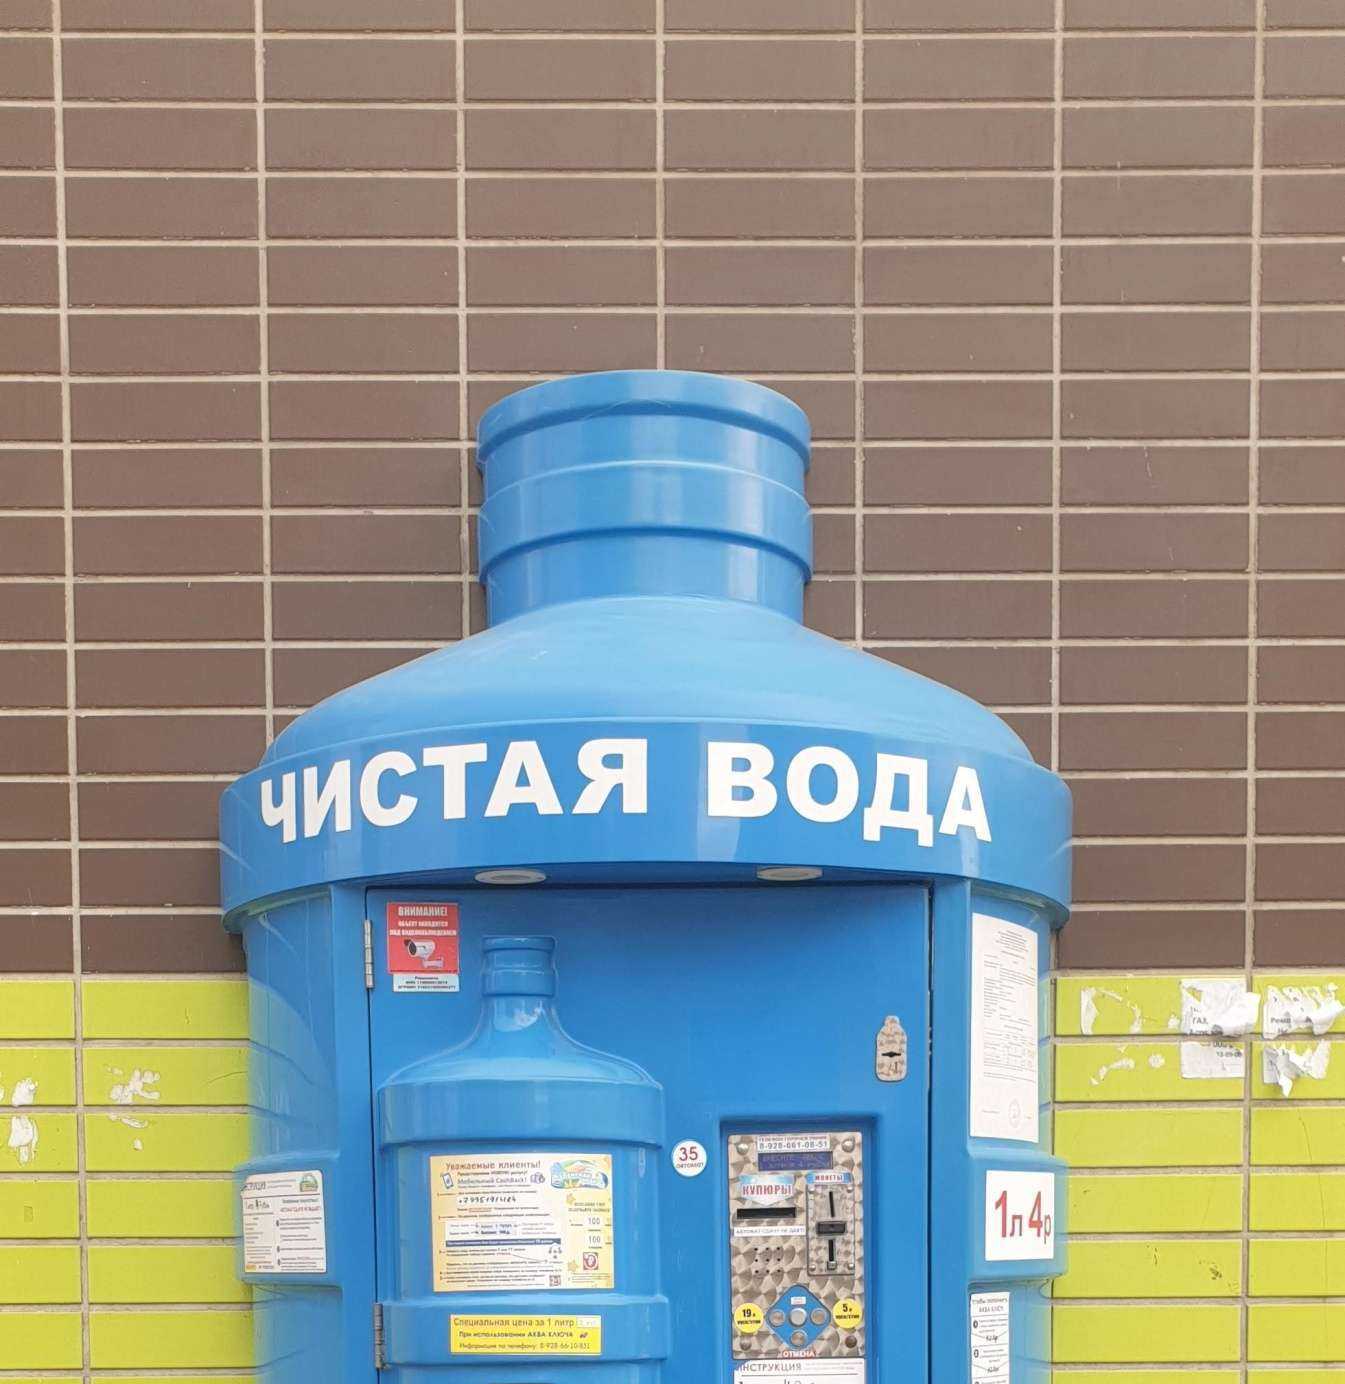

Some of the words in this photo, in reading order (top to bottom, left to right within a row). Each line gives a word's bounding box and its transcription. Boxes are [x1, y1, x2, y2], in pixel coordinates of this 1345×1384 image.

[261, 738, 648, 844] ЧИСТАЯ
[706, 741, 992, 847] ВОДА
[679, 1146, 698, 1161] 35
[446, 1162, 495, 1171] Уважаемые
[498, 1160, 541, 1169] клиенты!
[743, 1184, 793, 1196] КУПЮРЫ
[995, 1190, 1022, 1238] 1л
[1028, 1191, 1051, 1244] 4р
[742, 1309, 752, 1317] 19
[843, 1304, 848, 1312] 5
[454, 1318, 510, 1328] Специальная
[512, 1319, 533, 1328] цена
[535, 1319, 545, 1327] за
[554, 1319, 575, 1328] литр
